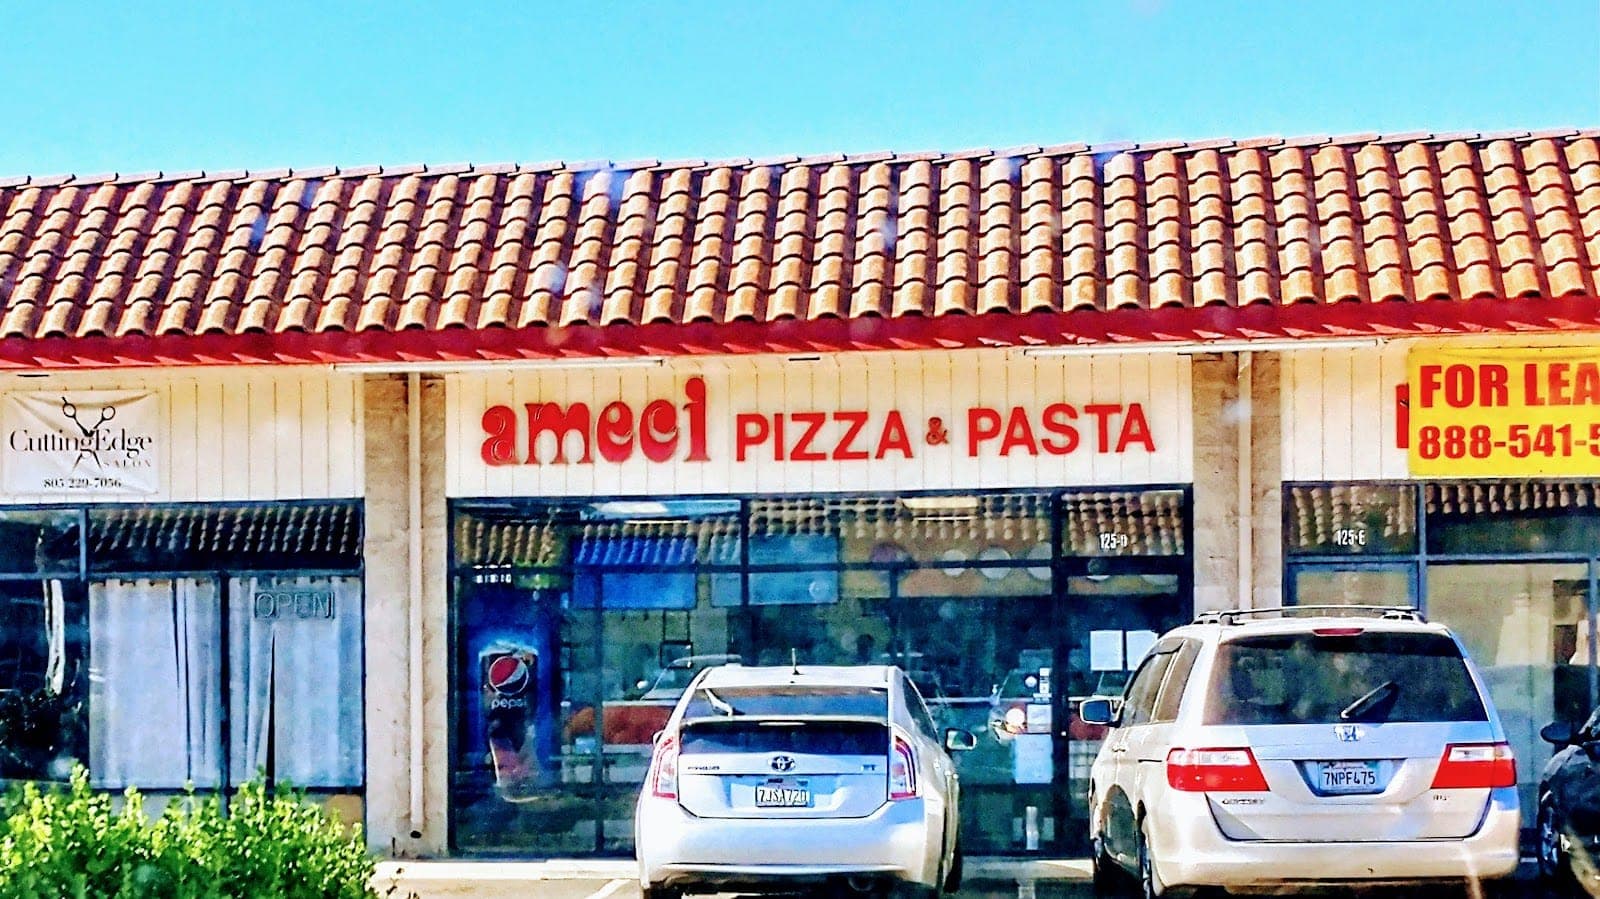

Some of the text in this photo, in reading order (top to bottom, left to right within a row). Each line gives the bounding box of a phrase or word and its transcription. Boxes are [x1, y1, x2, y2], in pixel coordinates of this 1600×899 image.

[1419, 364, 1510, 409] FOR
[480, 376, 1156, 468] ameci PIZZA & PASTA
[256, 592, 331, 618] OPEN
[1323, 770, 1377, 786] 7NPF475
